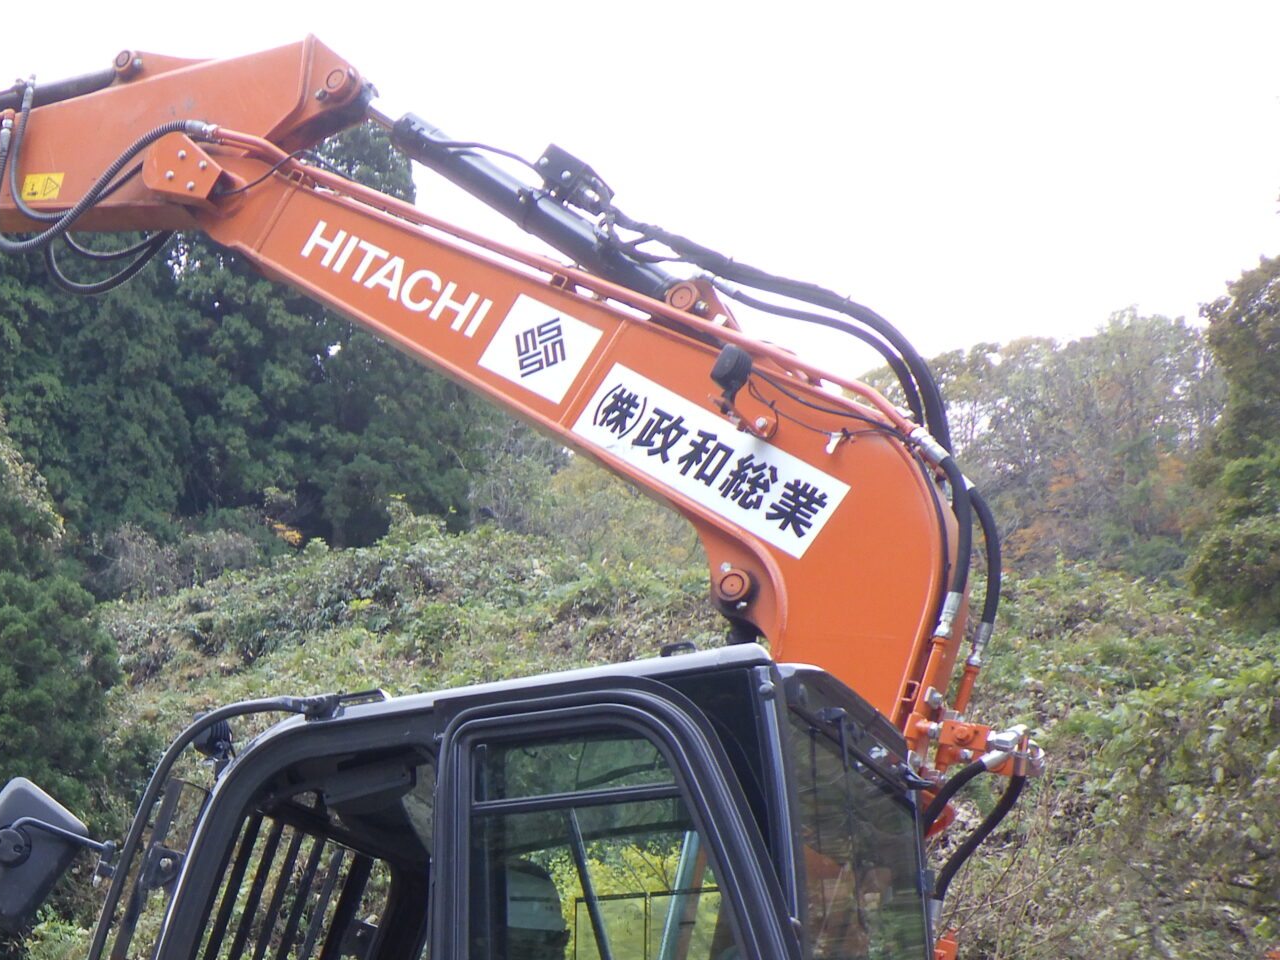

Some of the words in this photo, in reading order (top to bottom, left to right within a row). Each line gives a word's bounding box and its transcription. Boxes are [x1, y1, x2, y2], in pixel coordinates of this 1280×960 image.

[300, 219, 493, 338] HITACHI
[592, 382, 829, 539] (株)政和総業
